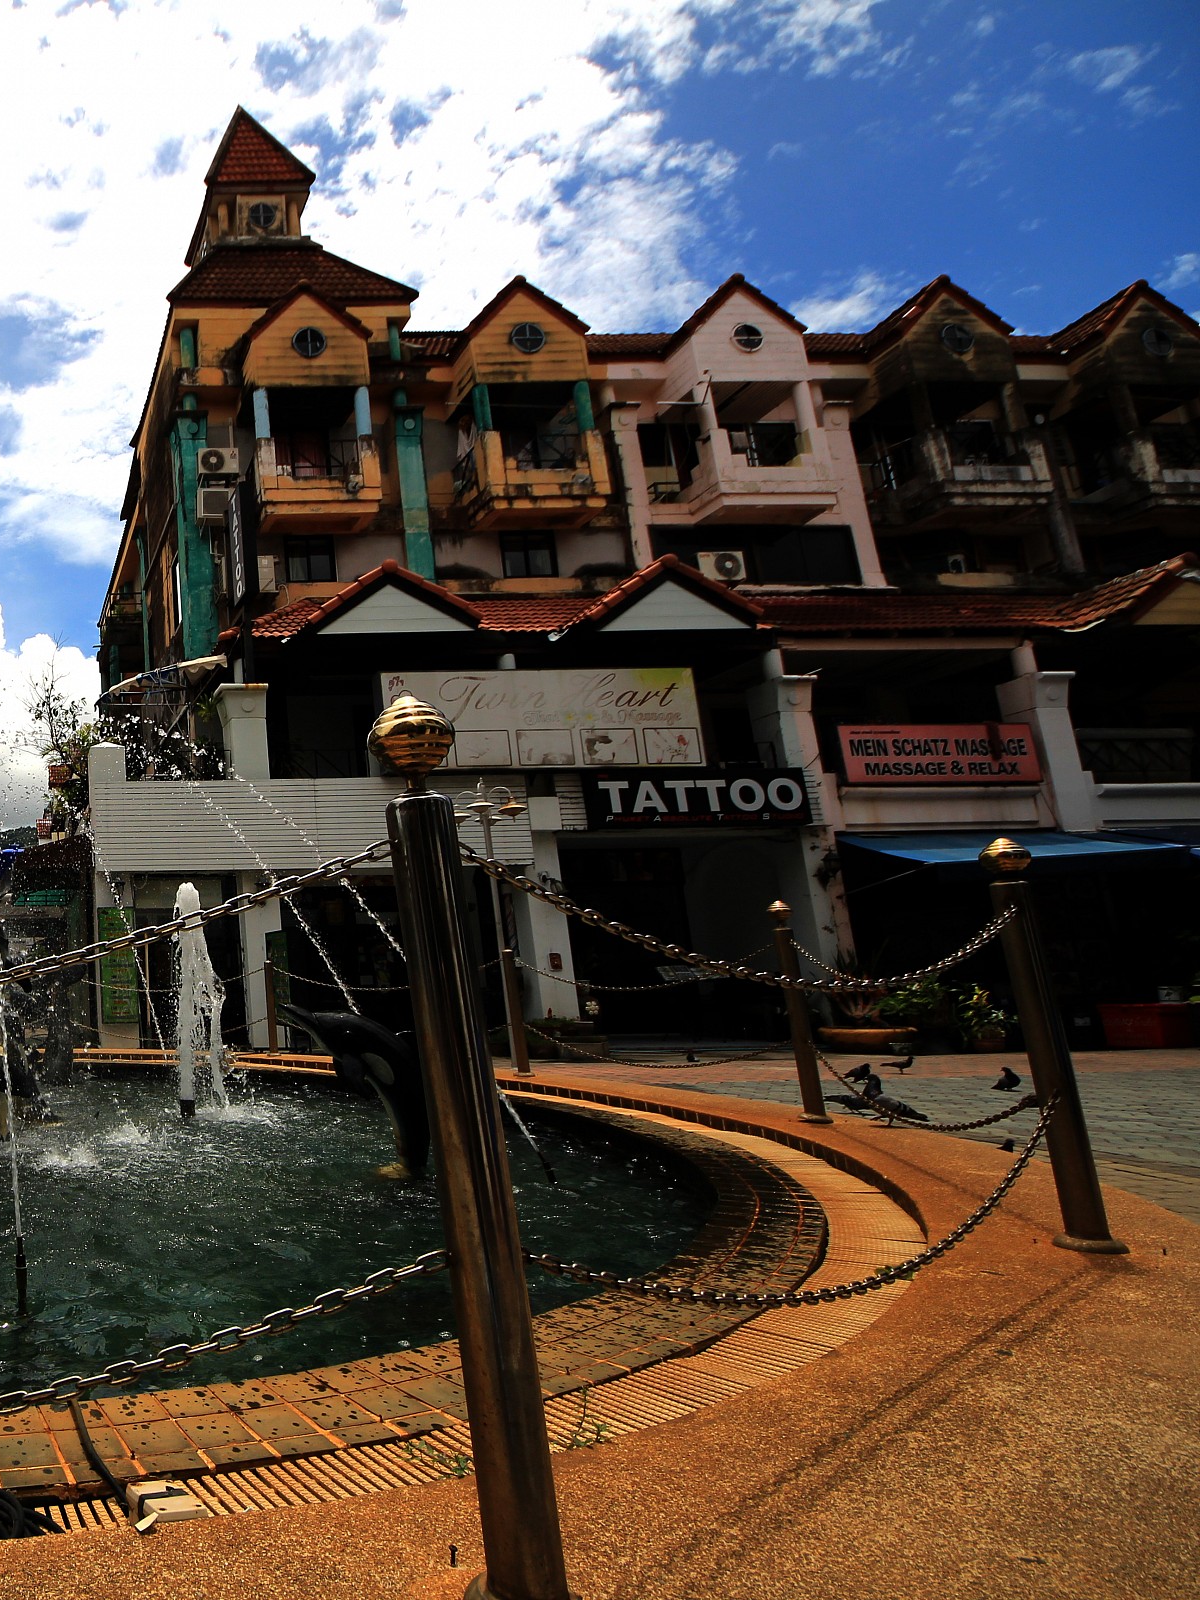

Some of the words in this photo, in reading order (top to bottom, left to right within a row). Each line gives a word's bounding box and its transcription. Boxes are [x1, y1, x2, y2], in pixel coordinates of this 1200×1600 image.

[231, 494, 242, 598] TATTOO
[438, 674, 546, 724] Twin
[561, 672, 679, 708] Heart
[616, 708, 682, 726] Massage
[849, 738, 888, 757] MEIN
[891, 738, 951, 757] SCHATZ
[864, 761, 948, 776] MASSAGE
[950, 760, 965, 776] &
[968, 761, 1020, 776] RELAX
[597, 777, 804, 814] TATTOO
[716, 813, 758, 821] TATTOO
